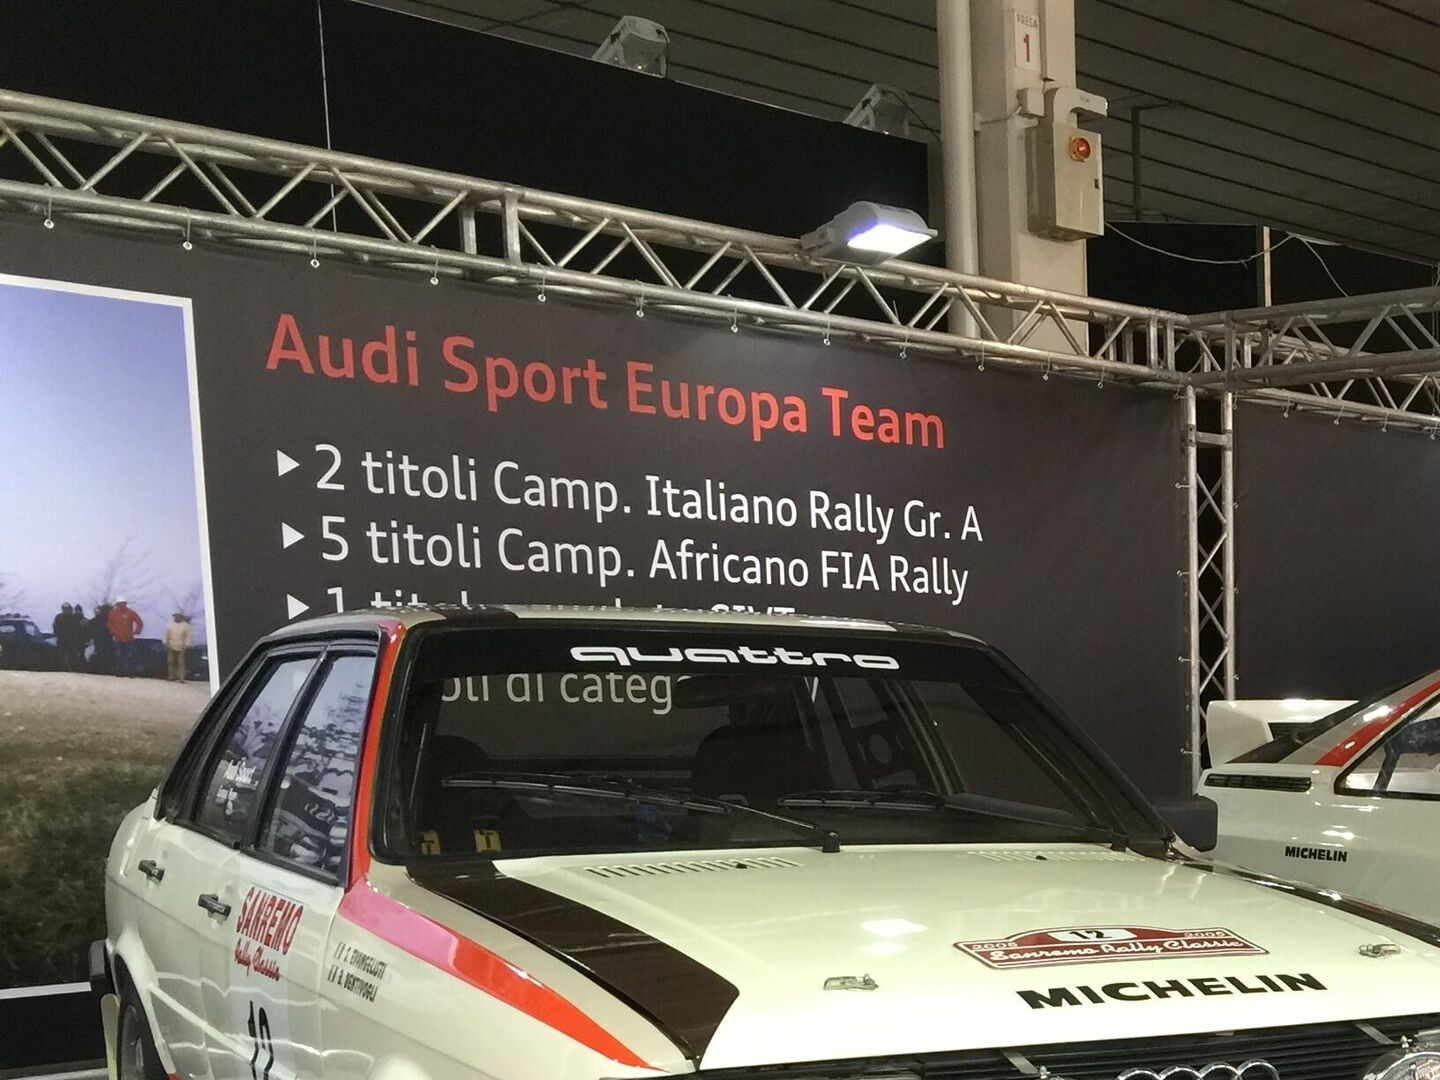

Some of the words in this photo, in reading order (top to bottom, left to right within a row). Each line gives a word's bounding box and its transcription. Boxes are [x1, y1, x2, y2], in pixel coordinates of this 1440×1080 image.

[1023, 34, 1030, 62] 1
[265, 313, 418, 386] Audi
[442, 336, 608, 412] Sport
[626, 361, 807, 441] Europa
[821, 386, 944, 448] Team
[315, 444, 344, 490] 2
[361, 450, 477, 501] titoli
[494, 461, 631, 522] Camp.
[646, 475, 797, 527] Italiano
[810, 490, 894, 544] Rally
[904, 500, 951, 539] Gr.
[961, 506, 983, 541] A
[321, 515, 349, 561] 5
[366, 520, 481, 568] titoli
[498, 527, 634, 587] Camp.
[649, 539, 809, 587] Africano
[821, 551, 879, 591] FIA
[890, 555, 968, 605] Rally
[570, 645, 900, 670] quattro
[1285, 846, 1348, 862] MICHELIN
[236, 886, 304, 955] SANREMO
[989, 947, 1099, 960] Sanremo
[1101, 942, 1162, 954] Rally
[1163, 940, 1243, 950] Classic
[1016, 973, 1328, 1010] MICHELIN
